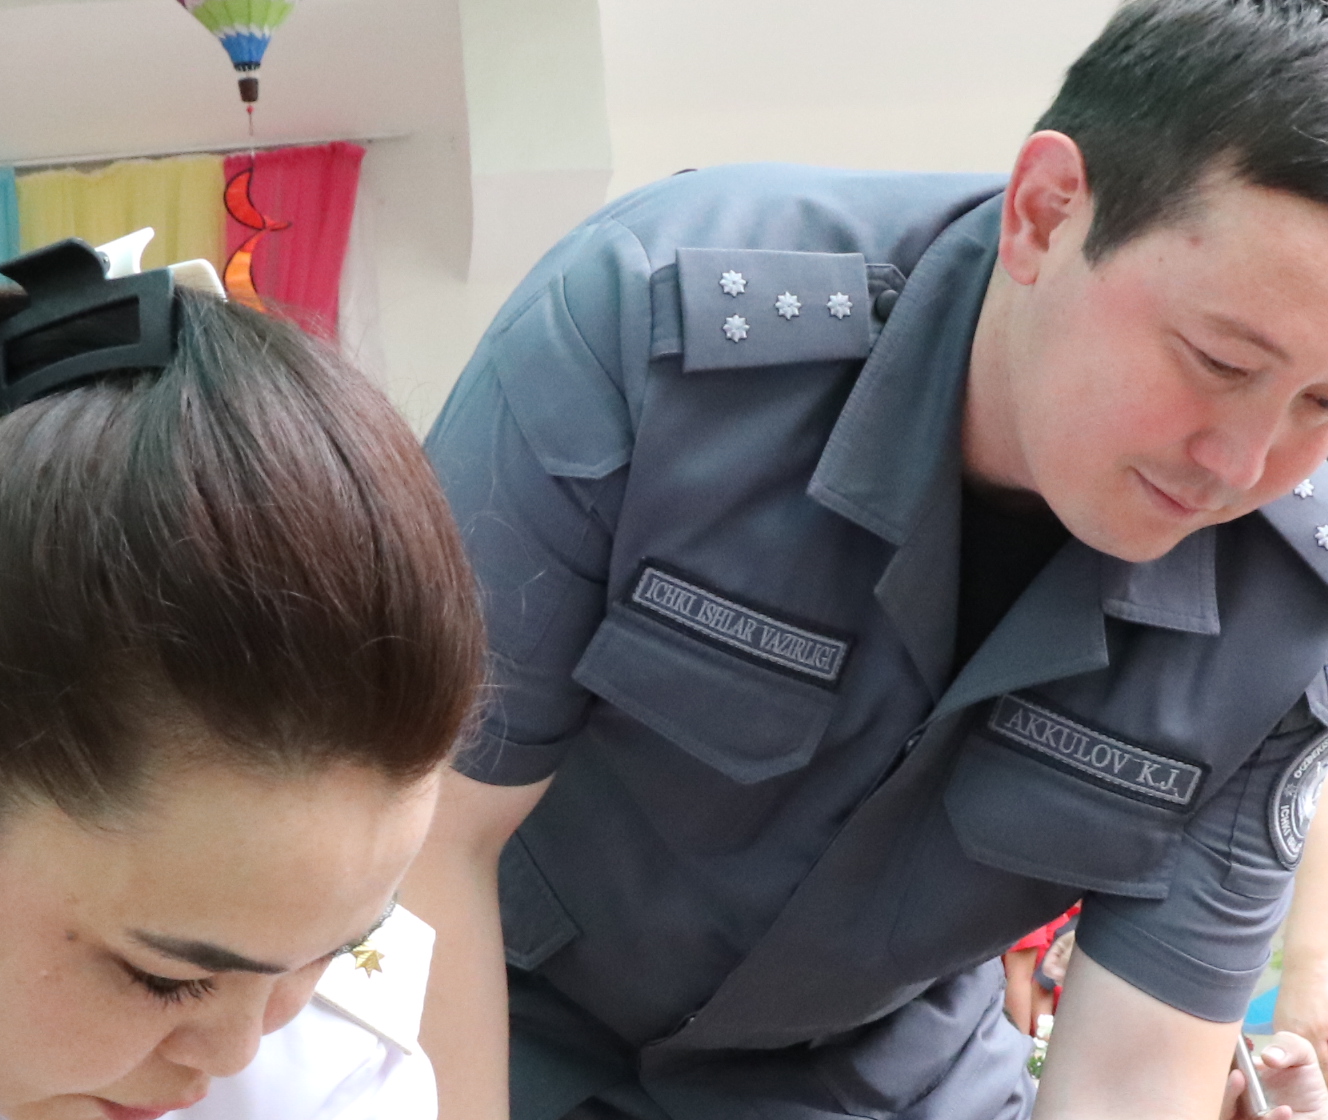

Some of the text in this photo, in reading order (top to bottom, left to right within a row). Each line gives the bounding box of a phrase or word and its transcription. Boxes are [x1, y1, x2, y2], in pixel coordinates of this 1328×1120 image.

[645, 577, 836, 671] ICHKI ISHLAR VAZIRLIGI
[1004, 707, 1134, 775] AKKULOV
